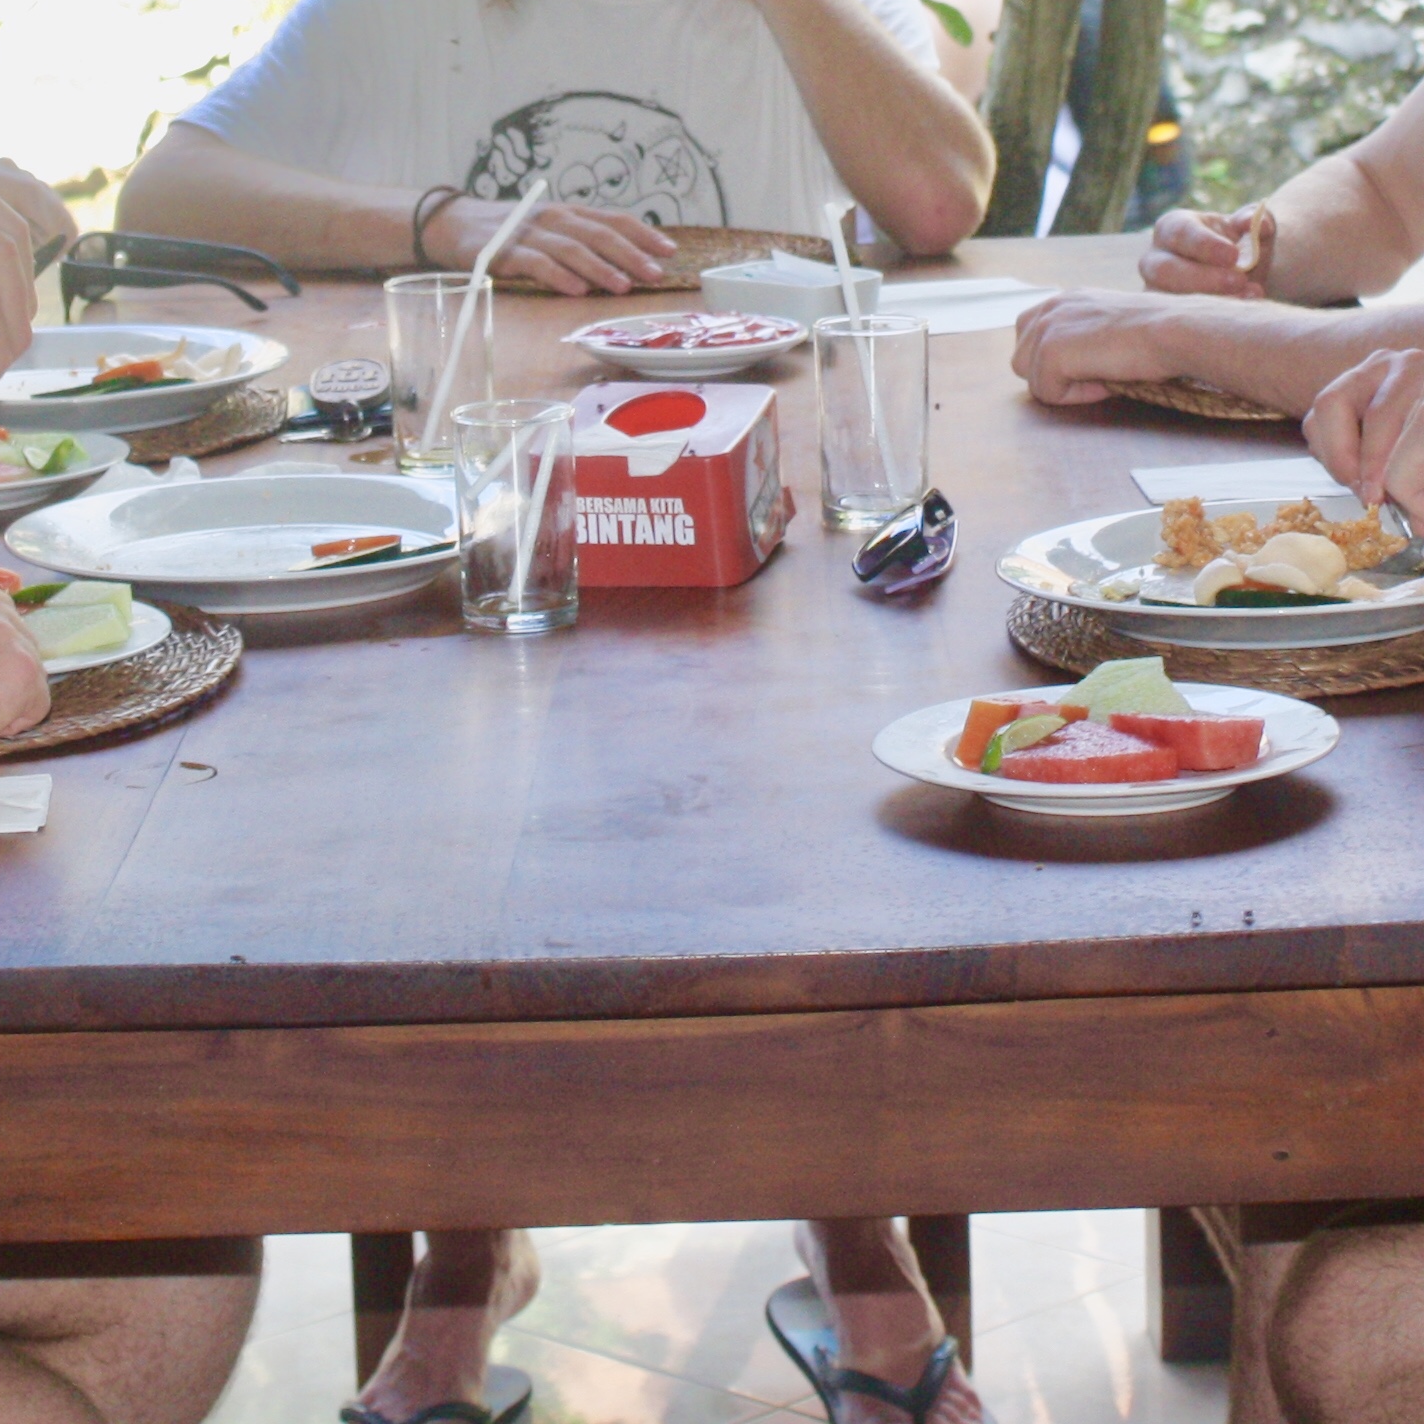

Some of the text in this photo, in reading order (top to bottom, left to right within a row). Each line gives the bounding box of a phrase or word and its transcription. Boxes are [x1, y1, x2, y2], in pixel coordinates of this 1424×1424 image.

[576, 496, 684, 514] BERSAMA KITA
[576, 513, 695, 545] BINTANG
